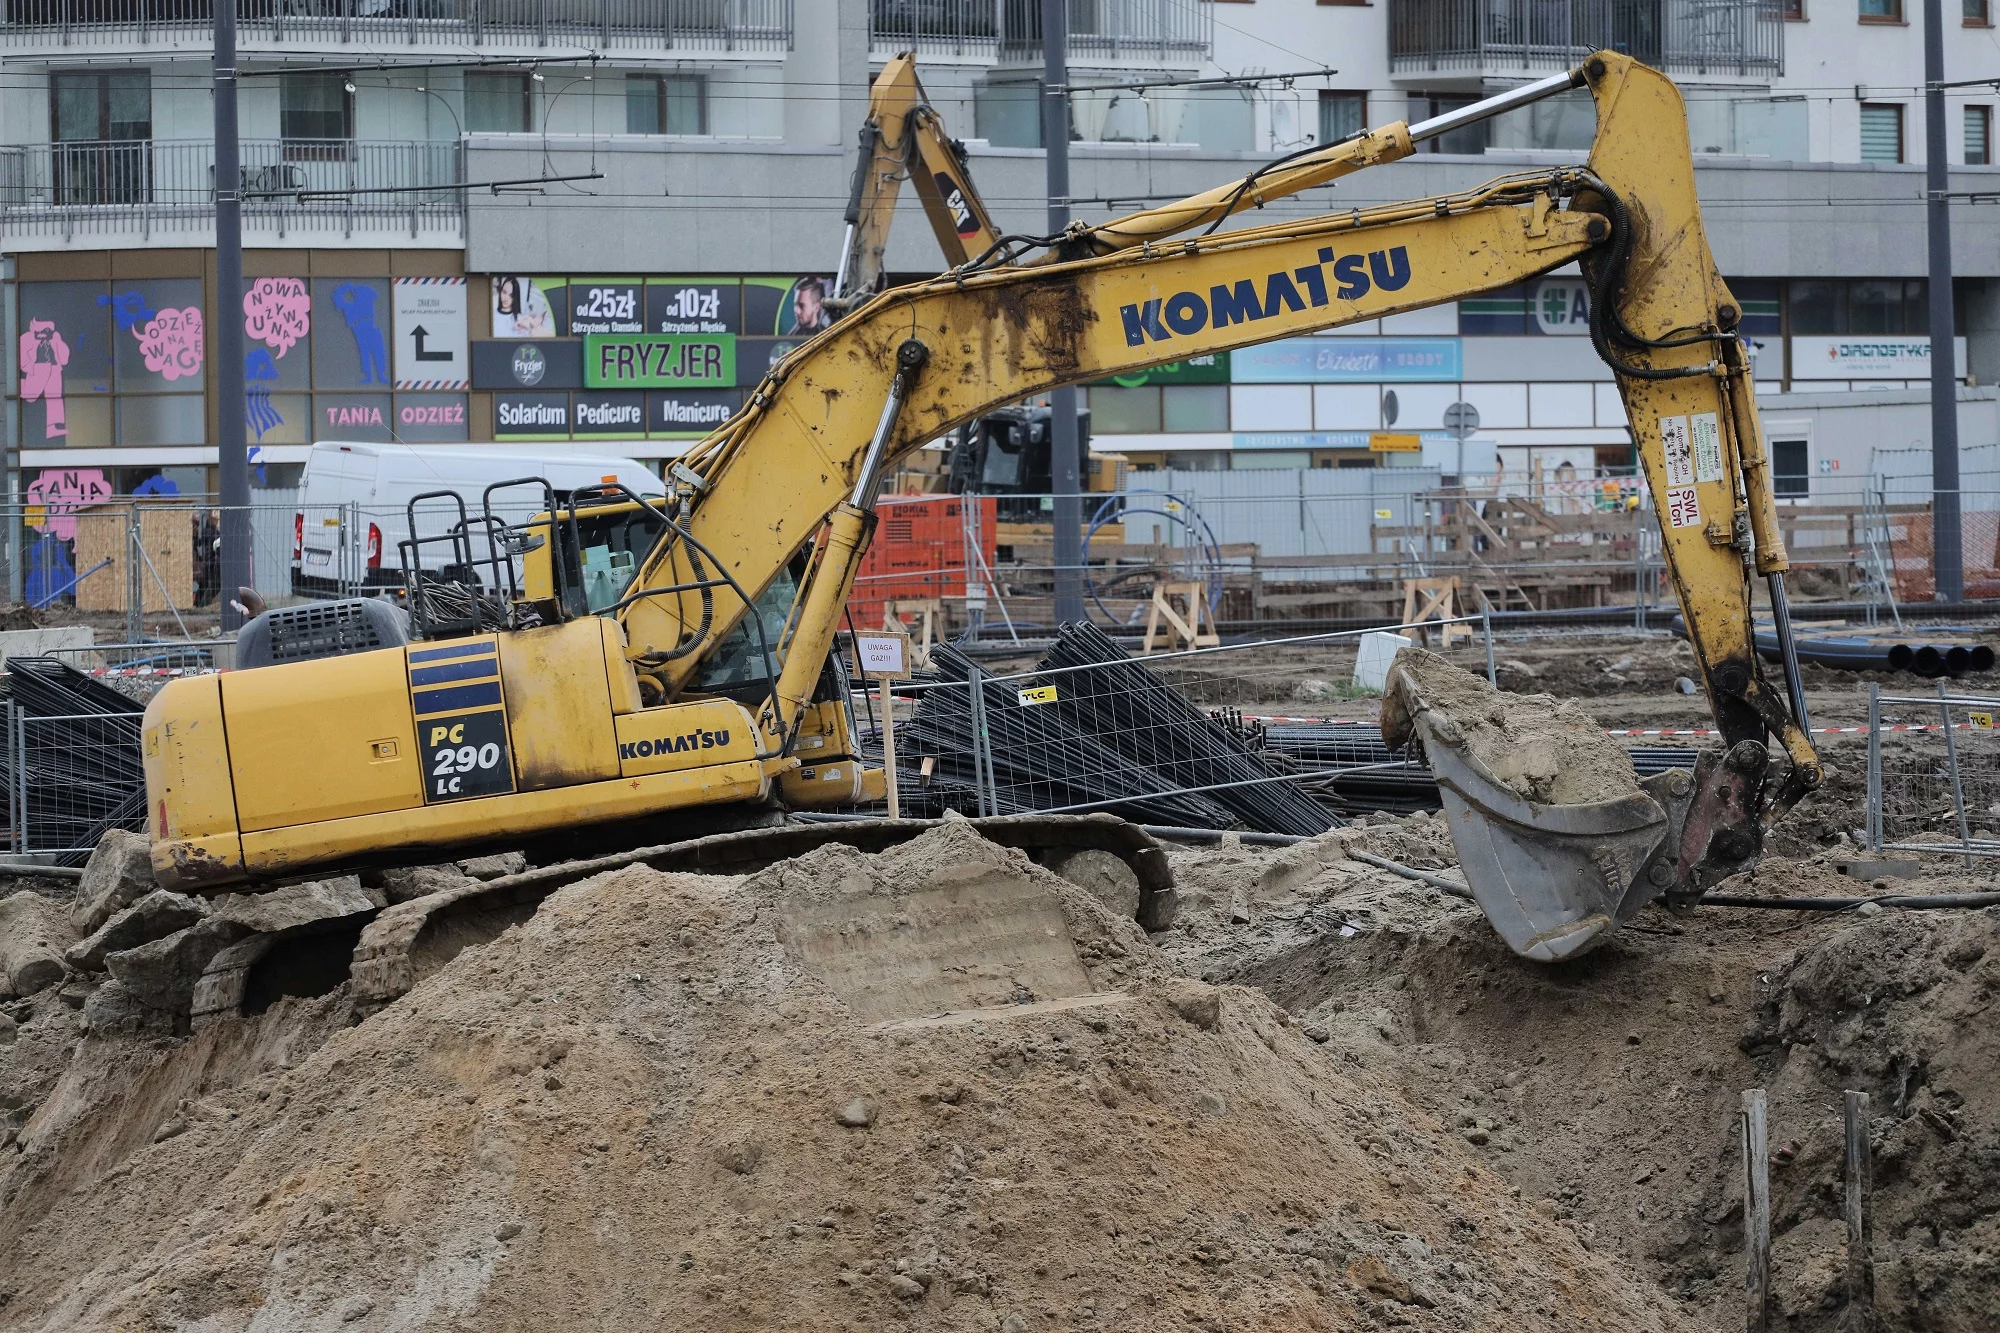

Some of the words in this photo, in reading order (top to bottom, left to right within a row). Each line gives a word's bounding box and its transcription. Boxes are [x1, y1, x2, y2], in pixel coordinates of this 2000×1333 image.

[251, 282, 303, 306] NOWA
[576, 304, 588, 317] od
[588, 288, 637, 319] 25zł
[666, 303, 678, 316] od
[674, 288, 720, 319] 10zł
[1119, 246, 1412, 348] KOMATSU
[168, 334, 185, 345] NA
[600, 343, 723, 380] FRYZJER
[327, 407, 383, 426] TANIA
[499, 403, 566, 425] Solarium
[577, 402, 641, 425] Pedicure
[663, 400, 731, 423] Manicure
[32, 472, 104, 501] TANIA
[1668, 490, 1680, 498] 1
[1682, 489, 1698, 523] SWL
[870, 654, 891, 662] GAZ!!!
[1022, 691, 1045, 700] TLC
[1970, 716, 1986, 726] TLC
[430, 723, 465, 747] PC
[620, 728, 730, 760] KOMATSU
[433, 742, 500, 776] 290
[436, 776, 461, 795] LC
